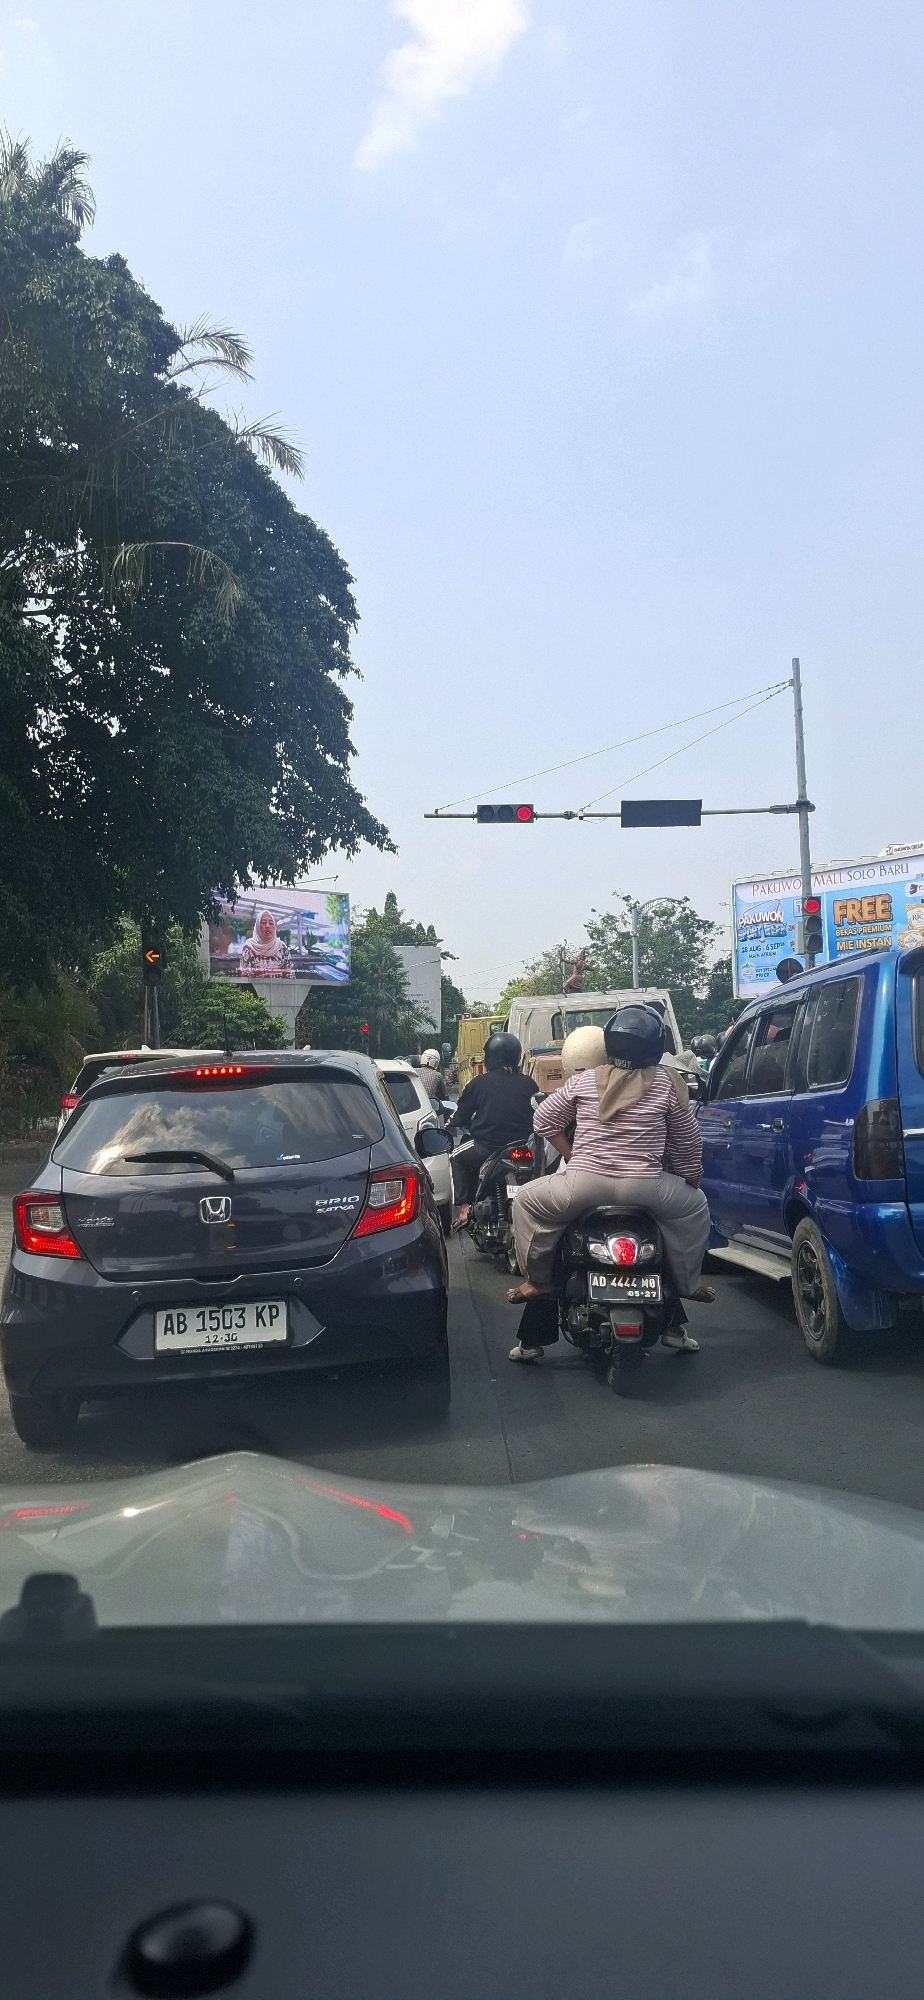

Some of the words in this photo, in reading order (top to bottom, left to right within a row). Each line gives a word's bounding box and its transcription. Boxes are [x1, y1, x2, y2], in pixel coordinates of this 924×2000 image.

[752, 878, 802, 897] PAKUWO
[813, 873, 844, 887] MALL
[847, 868, 876, 882] SOLO
[879, 863, 909, 877] BARU
[833, 893, 893, 927] FREE
[738, 911, 784, 928] PAKUWON
[835, 927, 857, 937] BERAS
[858, 924, 892, 934] PREMIUM
[749, 944, 762, 952] AUG
[836, 940, 855, 951] MIE
[856, 936, 892, 950] INSTAN
[315, 1195, 360, 1207] BRIO
[316, 1204, 355, 1215] SATYA
[592, 1275, 607, 1287] AD
[610, 1276, 637, 1288] 4444
[163, 1312, 188, 1335] AB
[195, 1307, 246, 1333] 1503
[255, 1304, 280, 1328] KP
